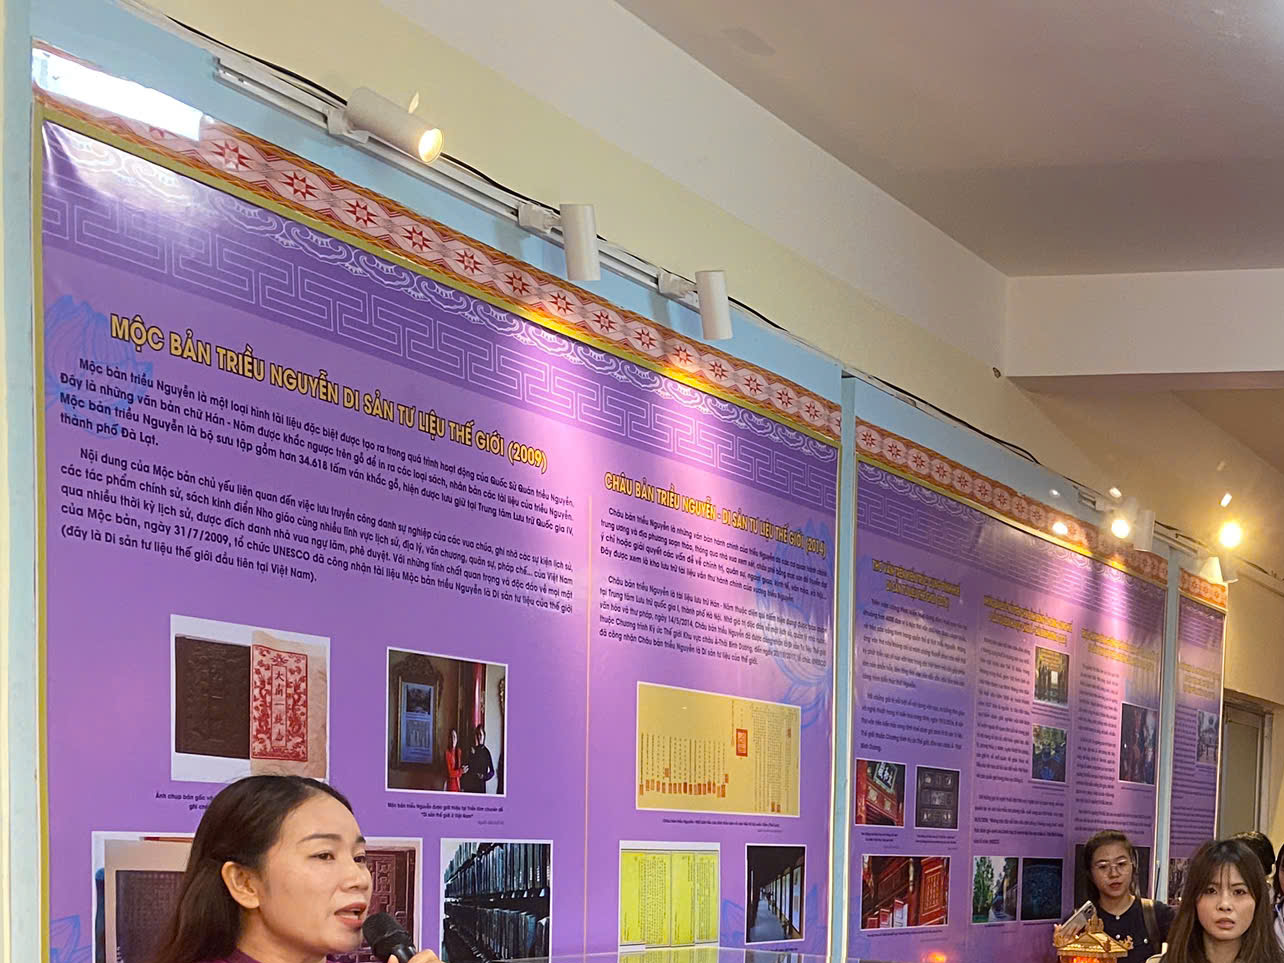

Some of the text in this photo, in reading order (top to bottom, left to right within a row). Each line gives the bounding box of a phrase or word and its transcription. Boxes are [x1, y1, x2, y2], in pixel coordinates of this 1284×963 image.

[60, 372, 82, 390] Đây
[85, 379, 96, 392] là
[99, 384, 134, 404] những
[136, 394, 157, 408] văn
[160, 399, 180, 414] bản
[183, 407, 203, 419] chữ
[204, 411, 224, 425] Hán
[233, 418, 254, 433] Nôm
[257, 426, 280, 441] được
[282, 432, 304, 447] khắc
[79, 358, 320, 435] Mộc bản triều Nguyễn là một loại hình tài liệu đặc
[110, 313, 547, 474] MỘC BẢN TRIỀU NGUYỄN DI SẢN TƯ LIỆU THẾ GIỚI (2009)
[59, 391, 327, 470] Mộc bản triều Nguyễn là bộ sưu tập gồm hơn 34.618
[60, 412, 158, 446] thành phố Đà Lạt.
[60, 463, 231, 509] các tác phẩm chính sử, sách kinh
[80, 447, 234, 492] Nội dung của Mộc bản chủ yếu
[605, 471, 632, 495] CHÂU
[634, 477, 654, 502] BẢN
[656, 484, 679, 509] TRIỀU
[681, 495, 715, 520] NGUYỄN
[721, 507, 730, 525] DI
[60, 484, 221, 526] qua nhiều thời kỳ lịch sử, được
[60, 502, 310, 560] của Mộc bản, ngày 31/7/2009, tổ chức UNESCO
[61, 524, 316, 582] (đây là Di sản tư liệu thế giới đầu tiên tại Việt Nam).
